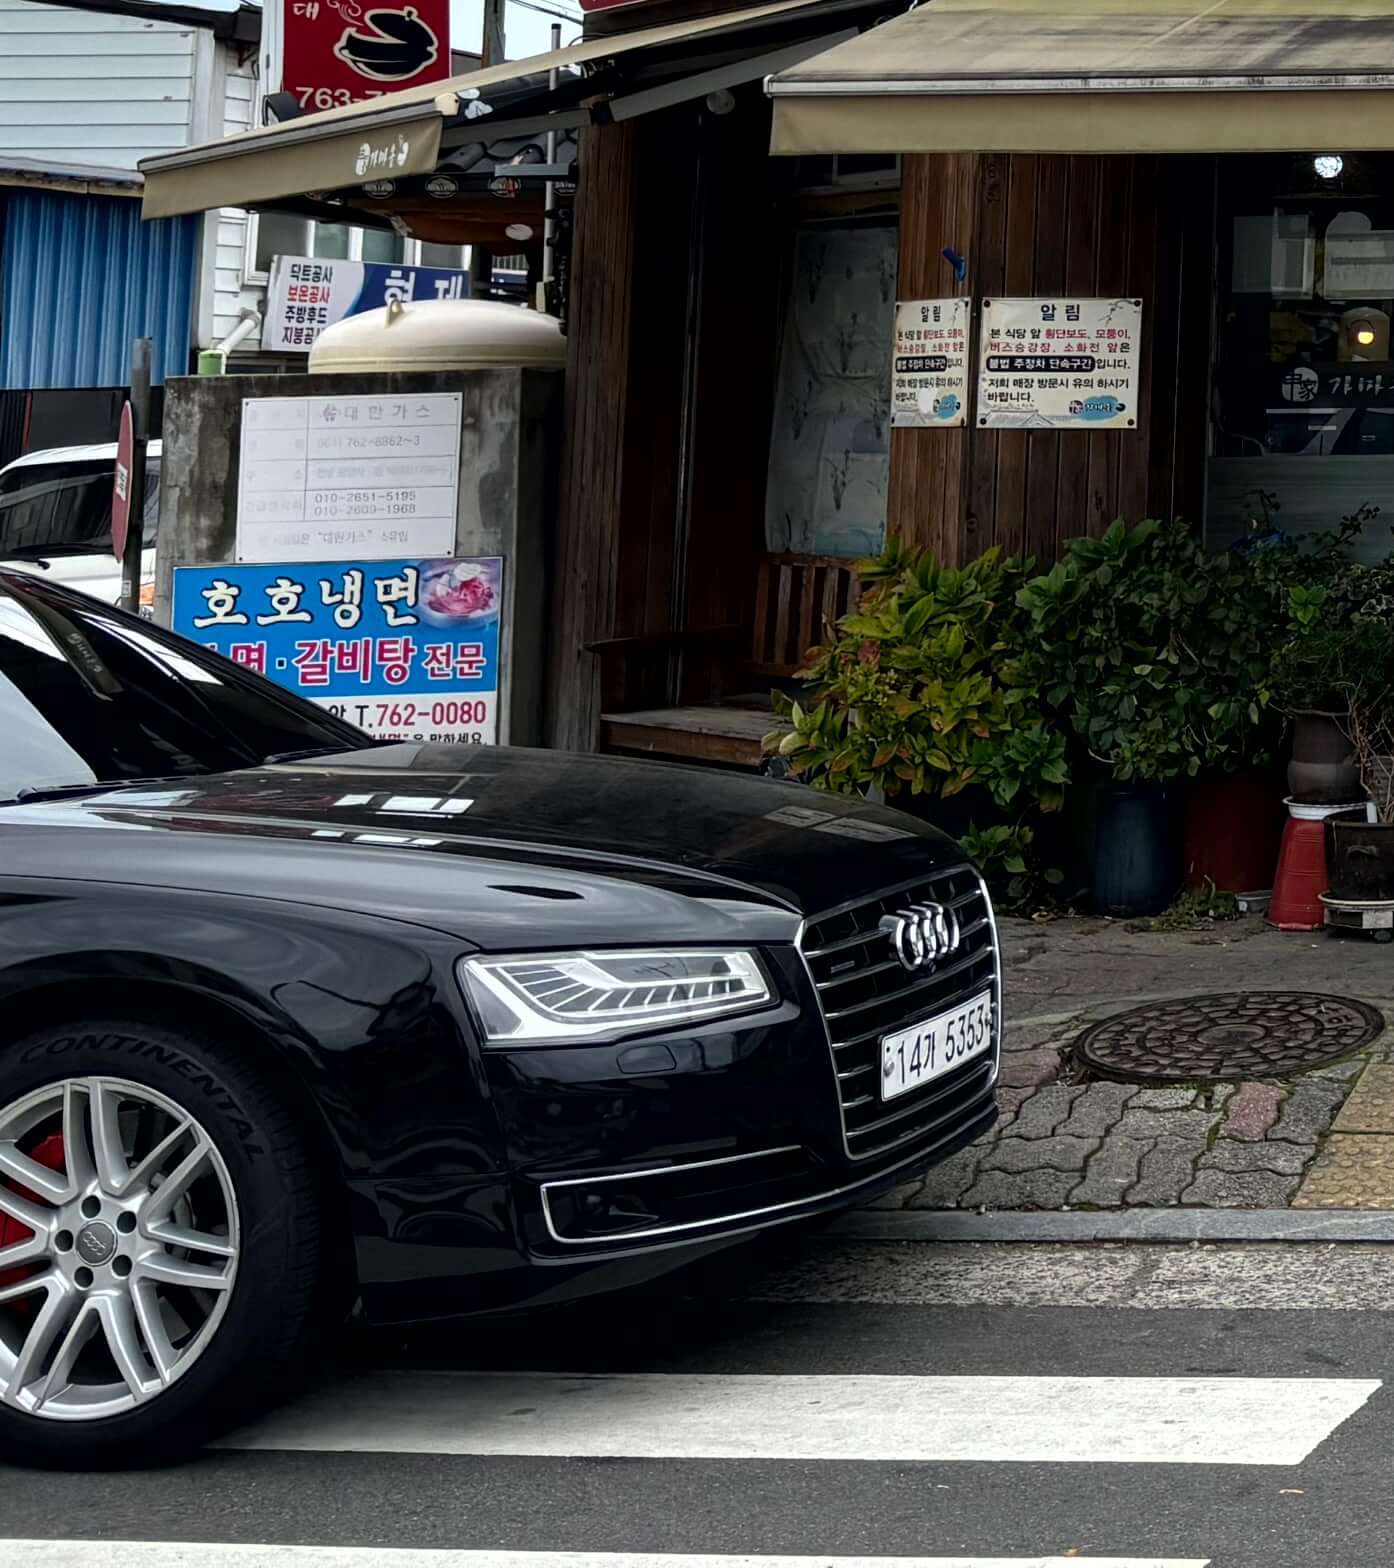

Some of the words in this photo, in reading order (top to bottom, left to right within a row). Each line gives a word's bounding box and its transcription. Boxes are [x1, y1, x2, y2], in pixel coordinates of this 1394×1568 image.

[284, 305, 328, 325] 주방후드
[287, 285, 331, 304] 보온공사
[193, 567, 419, 629] 호호냉면
[293, 635, 417, 686] 갈비탕
[422, 643, 487, 680] 전문
[945, 1003, 985, 1063] 5353
[20, 1032, 266, 1164] CONTINENTAL
